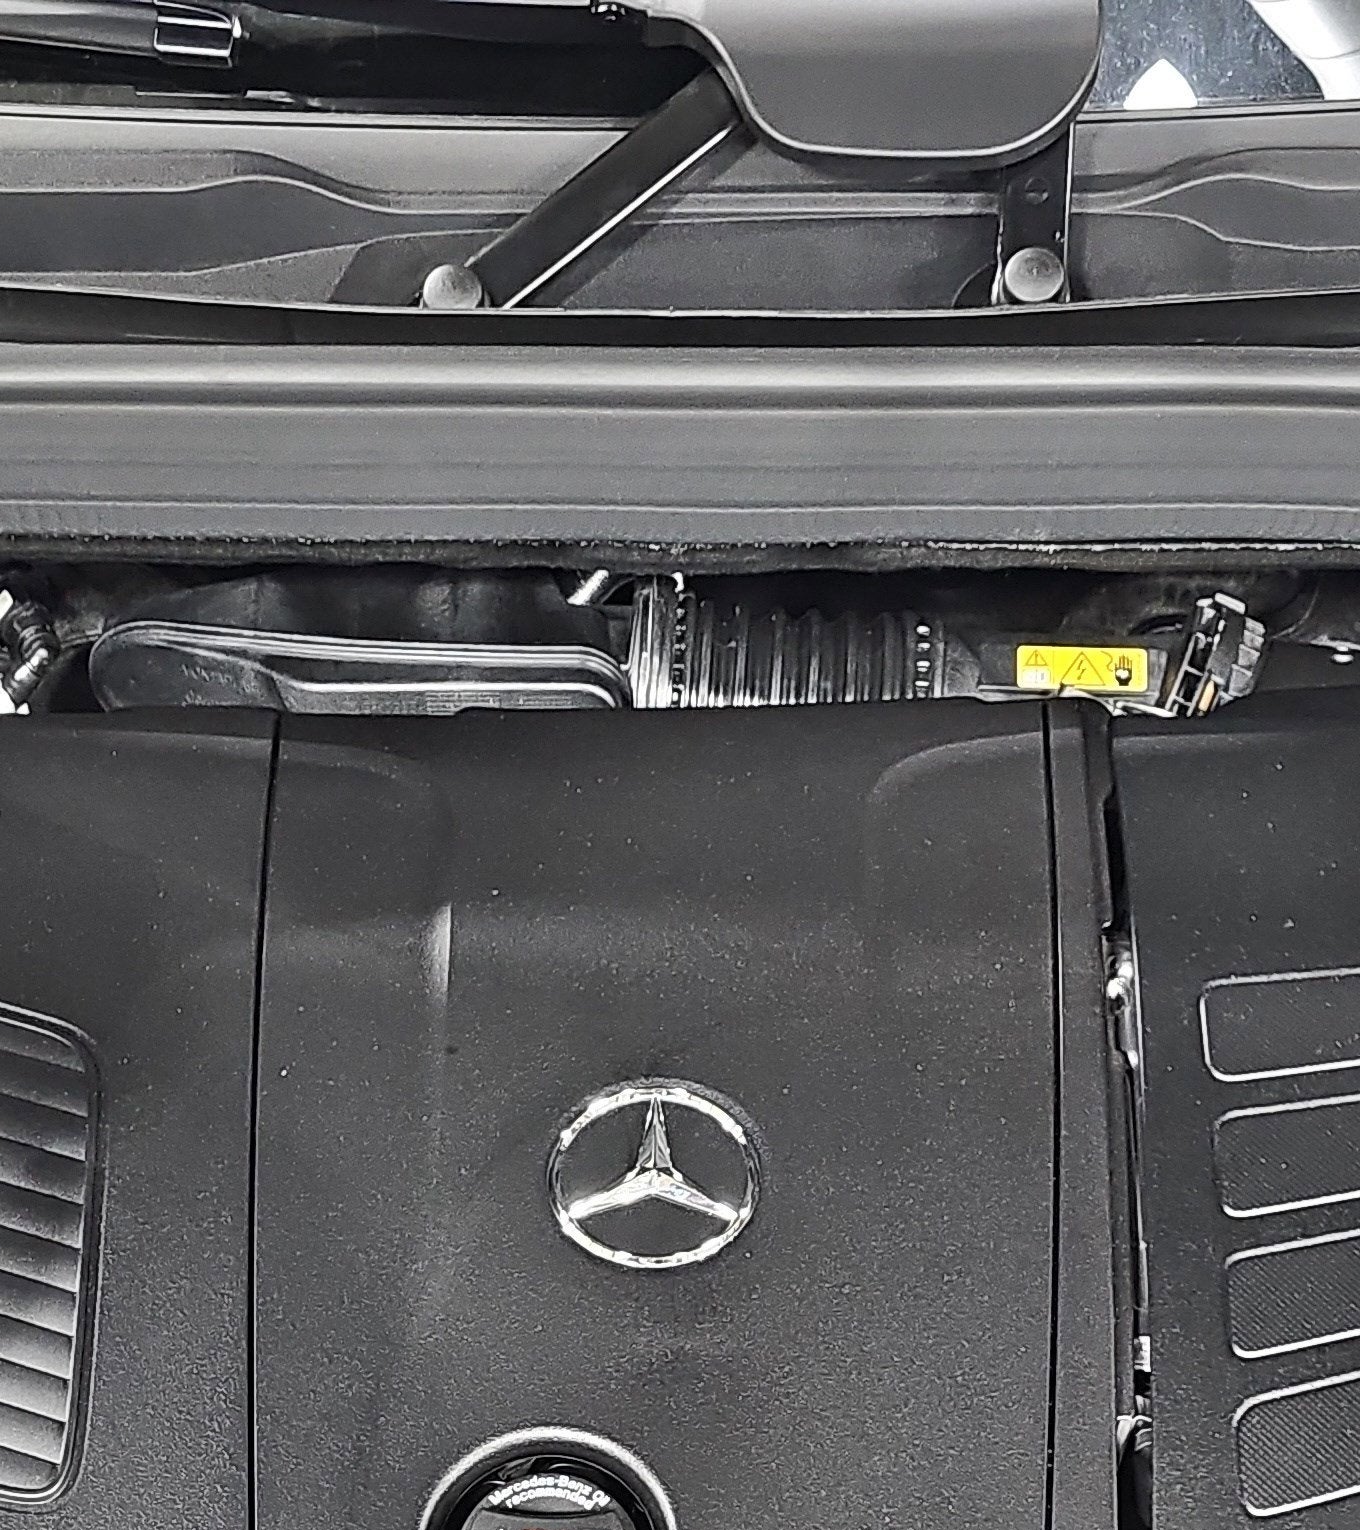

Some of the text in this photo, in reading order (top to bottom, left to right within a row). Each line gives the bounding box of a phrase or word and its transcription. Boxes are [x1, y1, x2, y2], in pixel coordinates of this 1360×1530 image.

[487, 1474, 611, 1508] Mercedes-Benz Oil
[505, 1486, 596, 1511] recommended
